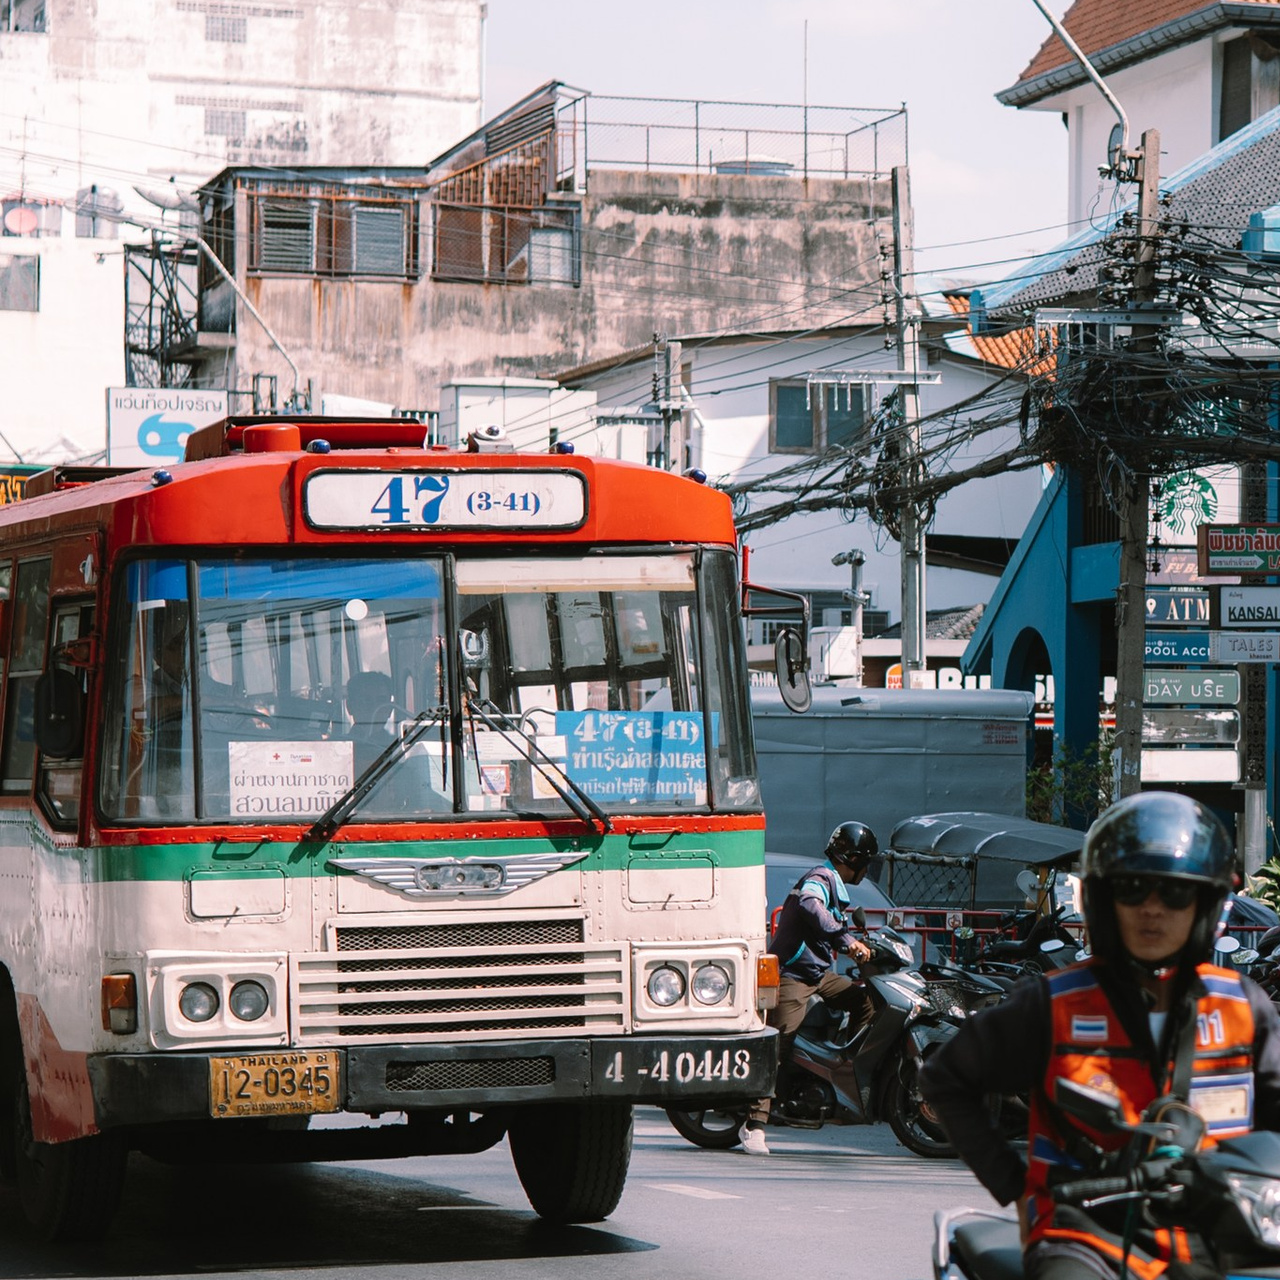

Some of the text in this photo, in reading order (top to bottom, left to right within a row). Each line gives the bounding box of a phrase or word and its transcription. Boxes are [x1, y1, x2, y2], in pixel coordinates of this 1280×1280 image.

[114, 393, 223, 413] แว่นท็อปเจริญ
[370, 475, 541, 524] 47 (3-41)
[1165, 597, 1210, 621] ATM
[1228, 606, 1278, 621] KANSAI
[1144, 646, 1178, 657] POOL
[1228, 638, 1274, 652] TALES
[1147, 684, 1225, 698] DAY USE
[573, 713, 701, 746] 47 (3-41)
[233, 769, 350, 787] ผ่านงานกาชาด
[239, 1055, 308, 1067] THAILAND
[222, 1065, 331, 1101] 12-0345
